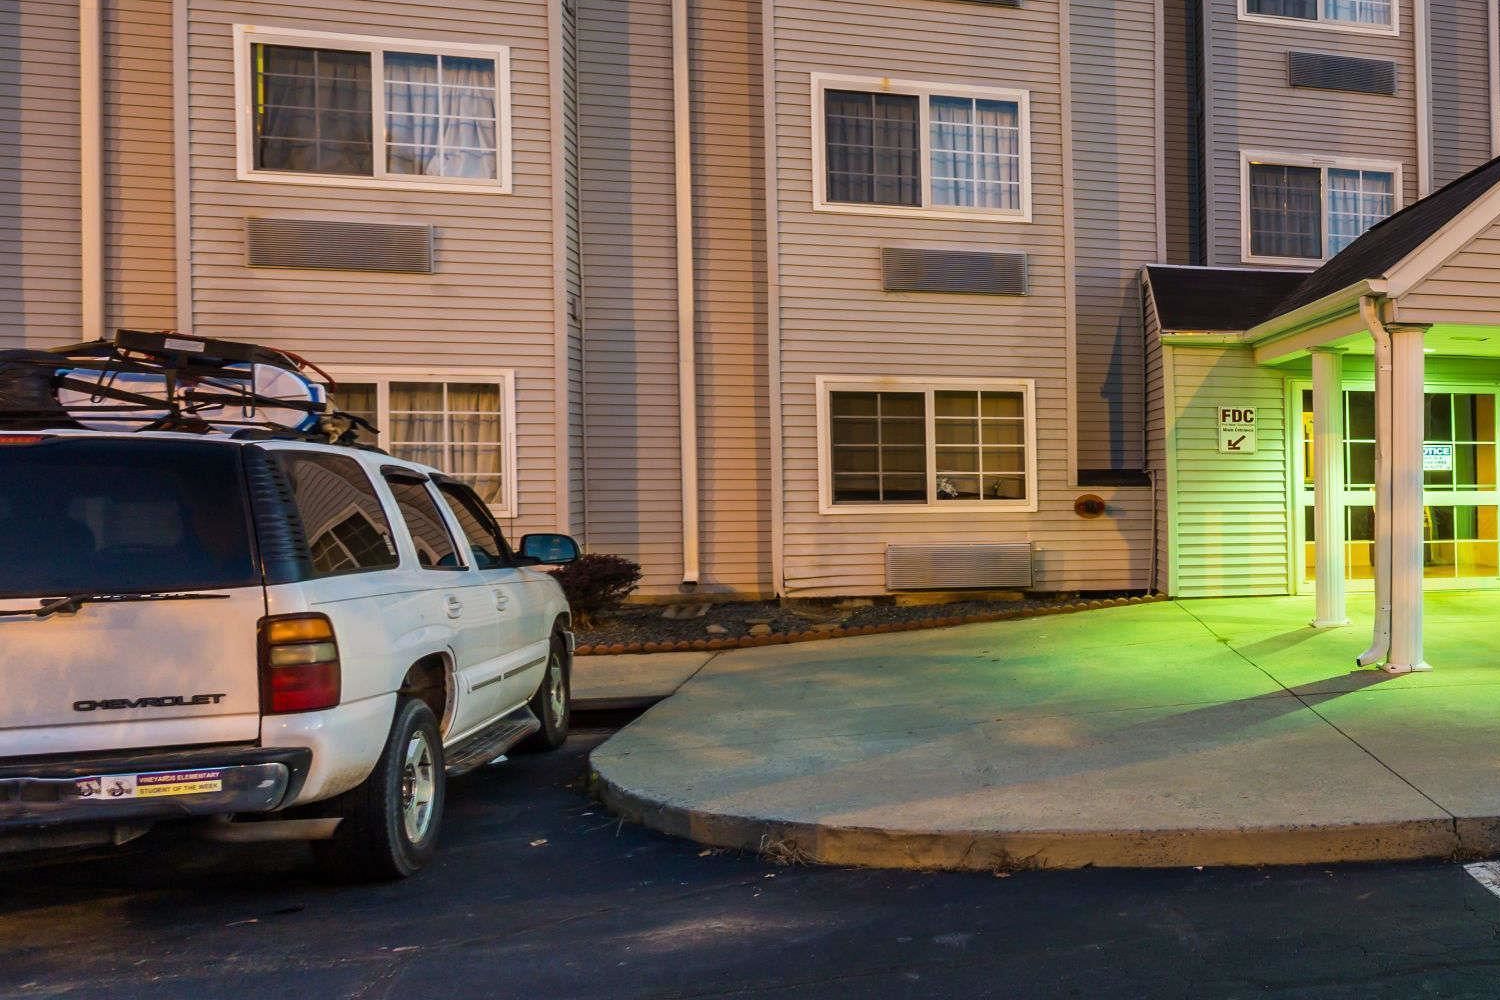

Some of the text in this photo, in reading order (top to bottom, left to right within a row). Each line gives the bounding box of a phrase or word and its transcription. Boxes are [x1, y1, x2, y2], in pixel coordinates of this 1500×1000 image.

[1222, 409, 1254, 423] FDC
[1423, 447, 1450, 455] OTICE
[73, 694, 226, 711] CHEVROLET
[140, 786, 171, 794] STUDENT
[184, 783, 196, 791] THE
[198, 782, 218, 790] WEEK
